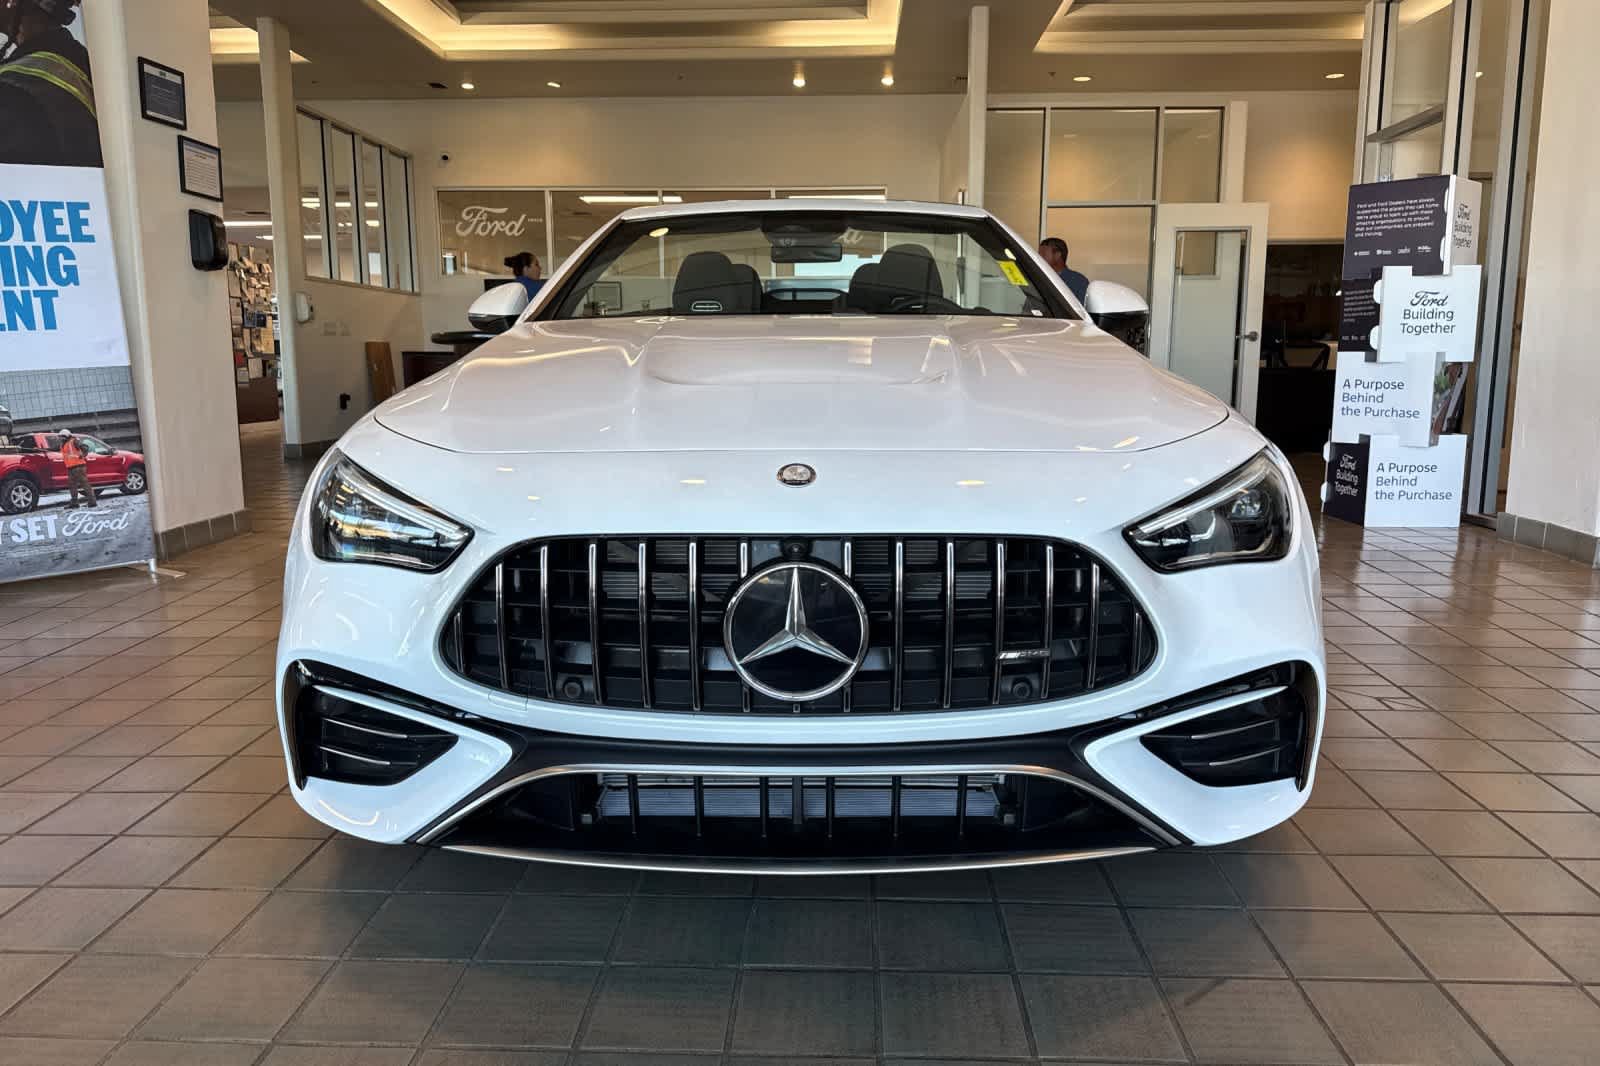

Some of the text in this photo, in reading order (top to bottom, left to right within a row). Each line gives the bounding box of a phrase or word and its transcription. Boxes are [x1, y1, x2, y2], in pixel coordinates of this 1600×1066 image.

[455, 205, 528, 238] Ford
[1410, 290, 1449, 307] Ford
[0, 290, 59, 331] NT
[1403, 308, 1454, 321] Building
[1400, 322, 1456, 336] Together
[1343, 379, 1405, 391] A Purpose
[1342, 392, 1384, 403] Behind
[1341, 406, 1420, 419] the Purchase
[1376, 462, 1438, 475] A Purpose
[1376, 476, 1418, 487] Behind
[1375, 489, 1453, 501] the Purchase
[9, 514, 58, 543] SET
[62, 509, 129, 537] Ford
